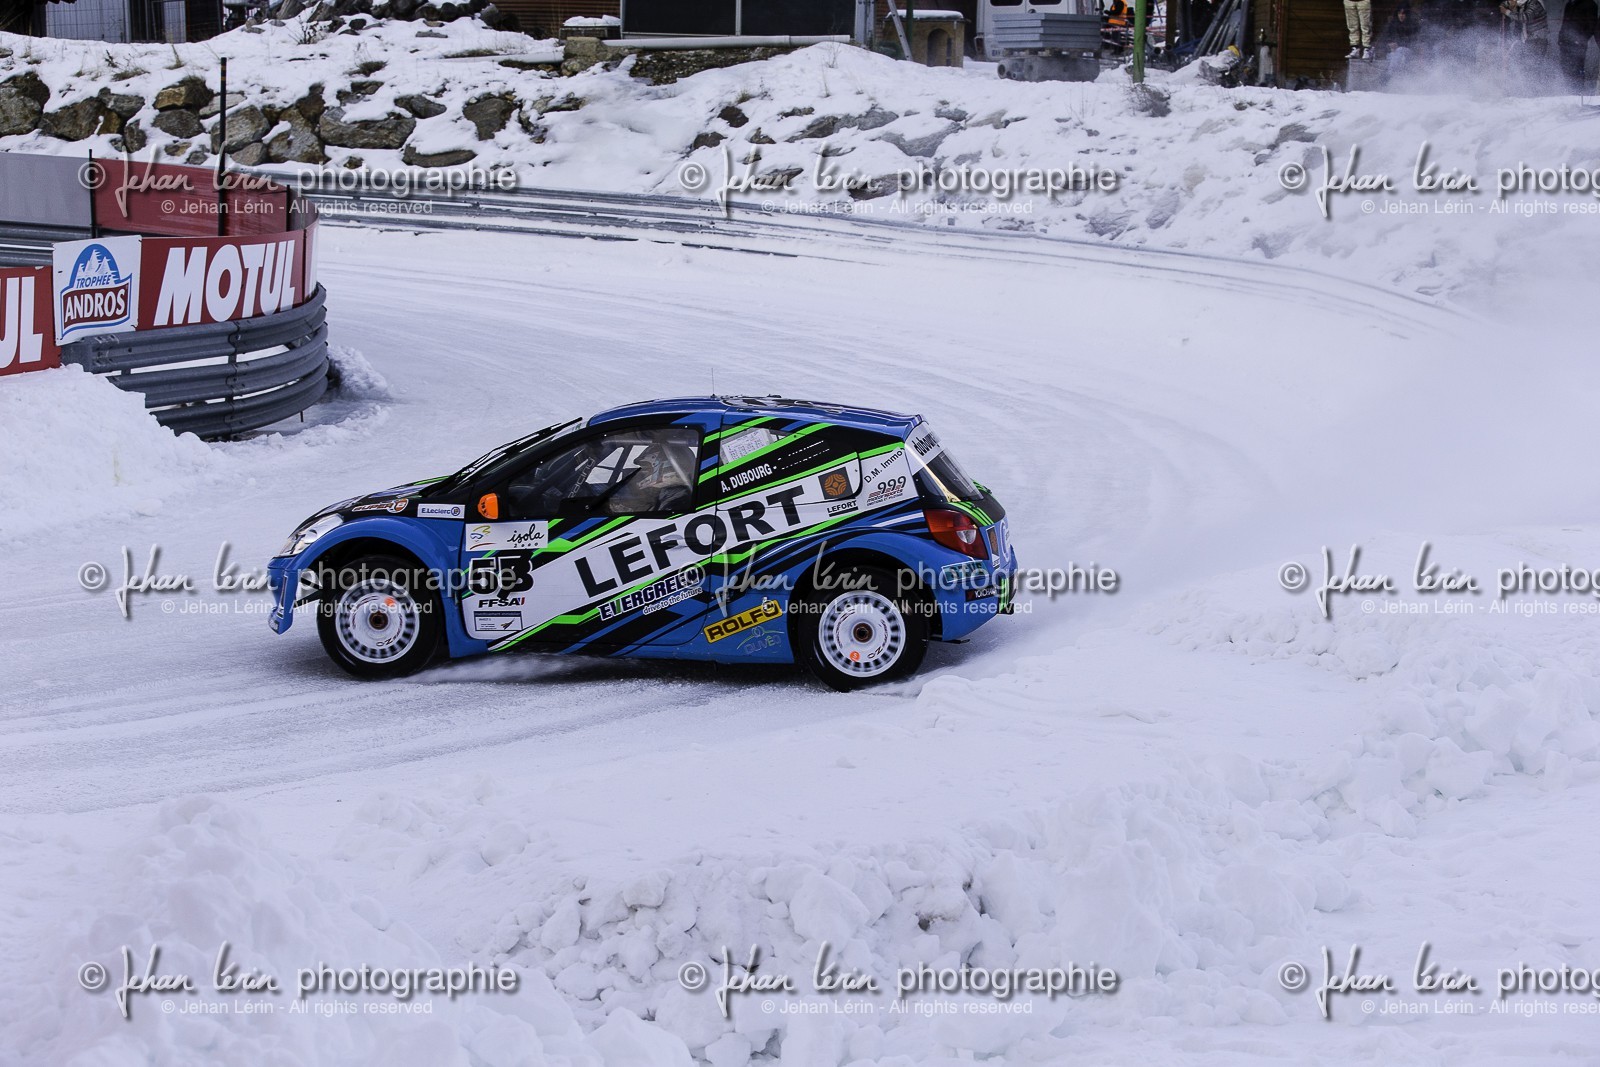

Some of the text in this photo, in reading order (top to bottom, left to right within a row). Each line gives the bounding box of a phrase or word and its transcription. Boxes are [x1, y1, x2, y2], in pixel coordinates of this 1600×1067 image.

[76, 274, 112, 289] TROPHÉE
[153, 239, 296, 327] MOTUL
[65, 288, 126, 323] ANDROS
[880, 450, 903, 469] Immo
[720, 480, 731, 493] A.
[729, 463, 772, 489] DUBOURG
[877, 475, 907, 494] 999
[827, 500, 857, 514] LEFORT
[507, 523, 545, 543] isola
[574, 484, 804, 599] LEFORT
[478, 597, 520, 609] FFSA
[599, 567, 700, 621] EVERGREEN
[643, 586, 703, 615] drive to the future
